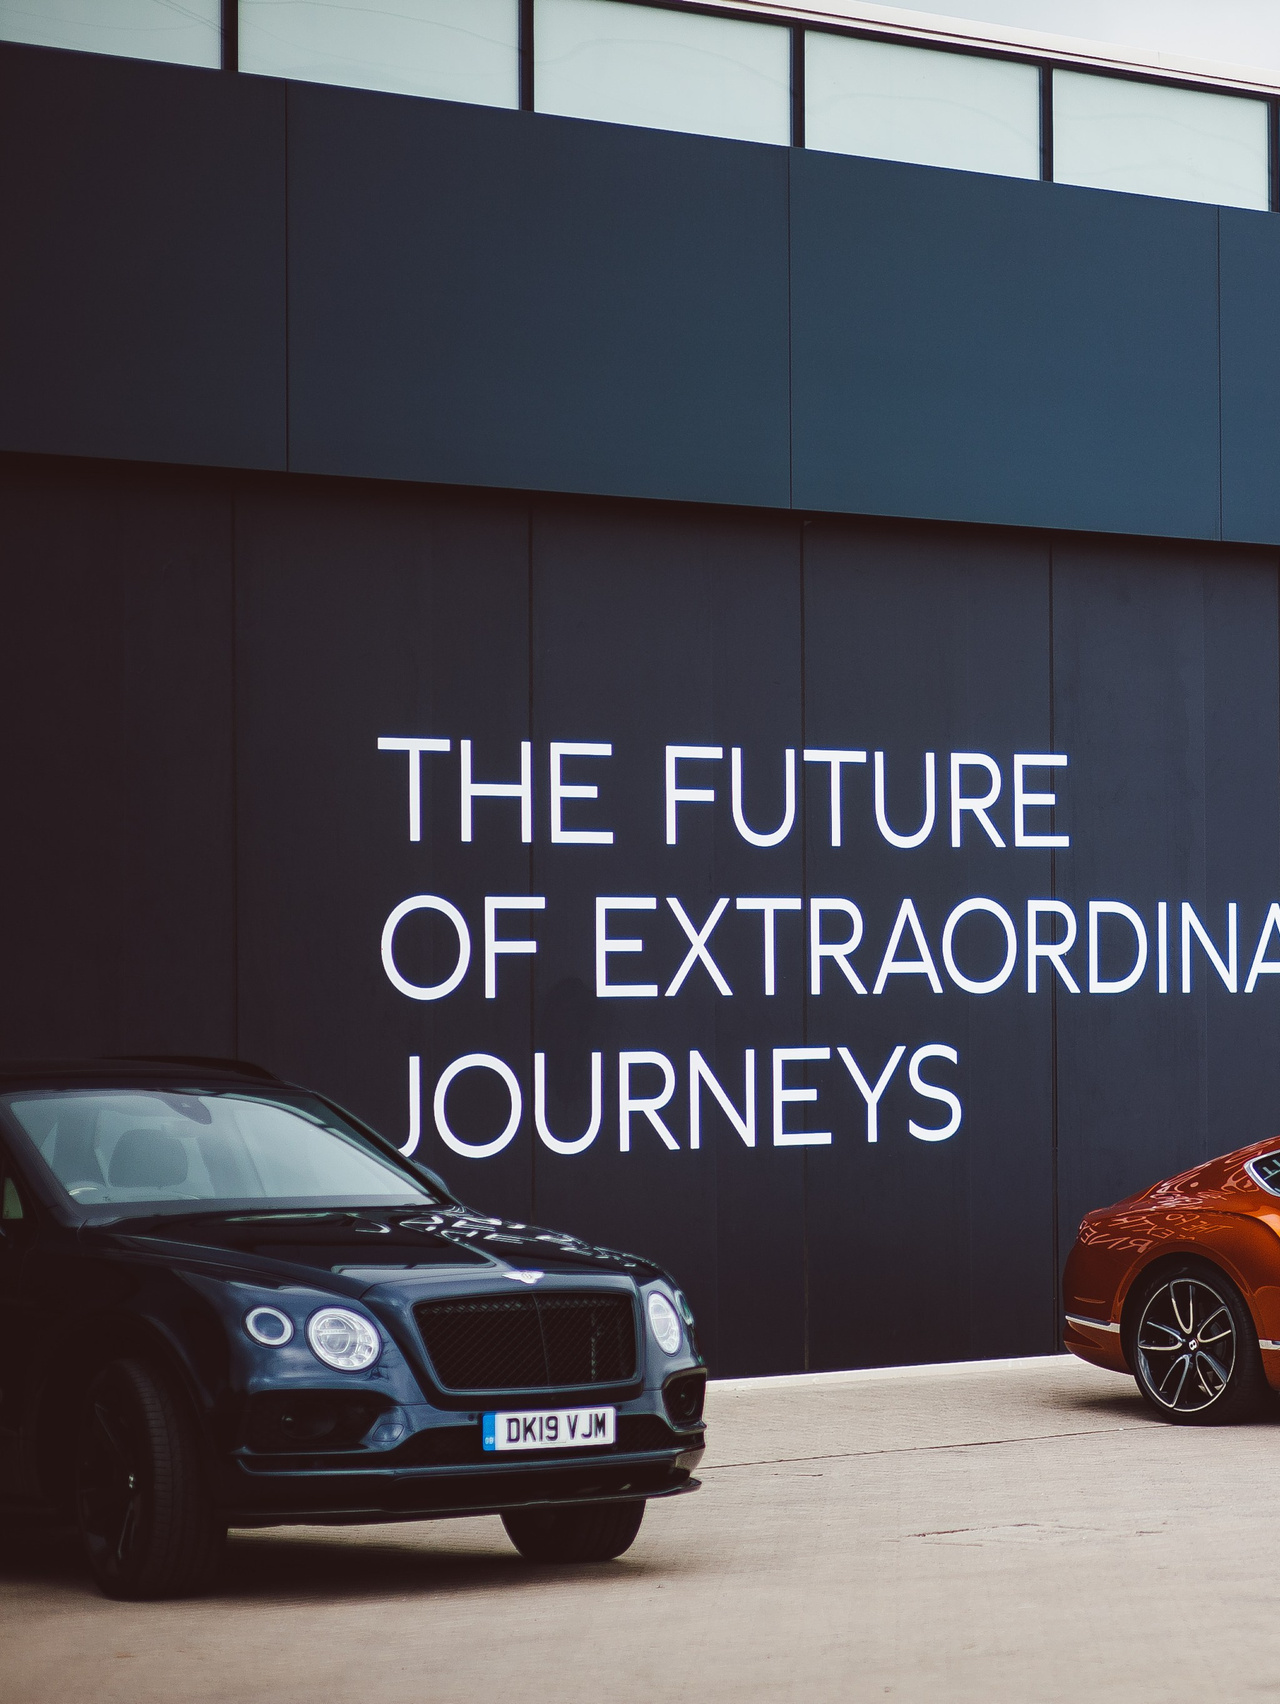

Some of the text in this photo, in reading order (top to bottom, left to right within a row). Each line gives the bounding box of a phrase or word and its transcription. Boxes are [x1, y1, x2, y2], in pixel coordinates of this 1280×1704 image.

[377, 737, 1070, 848] THE FUTURE
[380, 895, 546, 1000] OF
[398, 1044, 963, 1159] JOURNEYS
[506, 1412, 606, 1443] DK19 VJM
